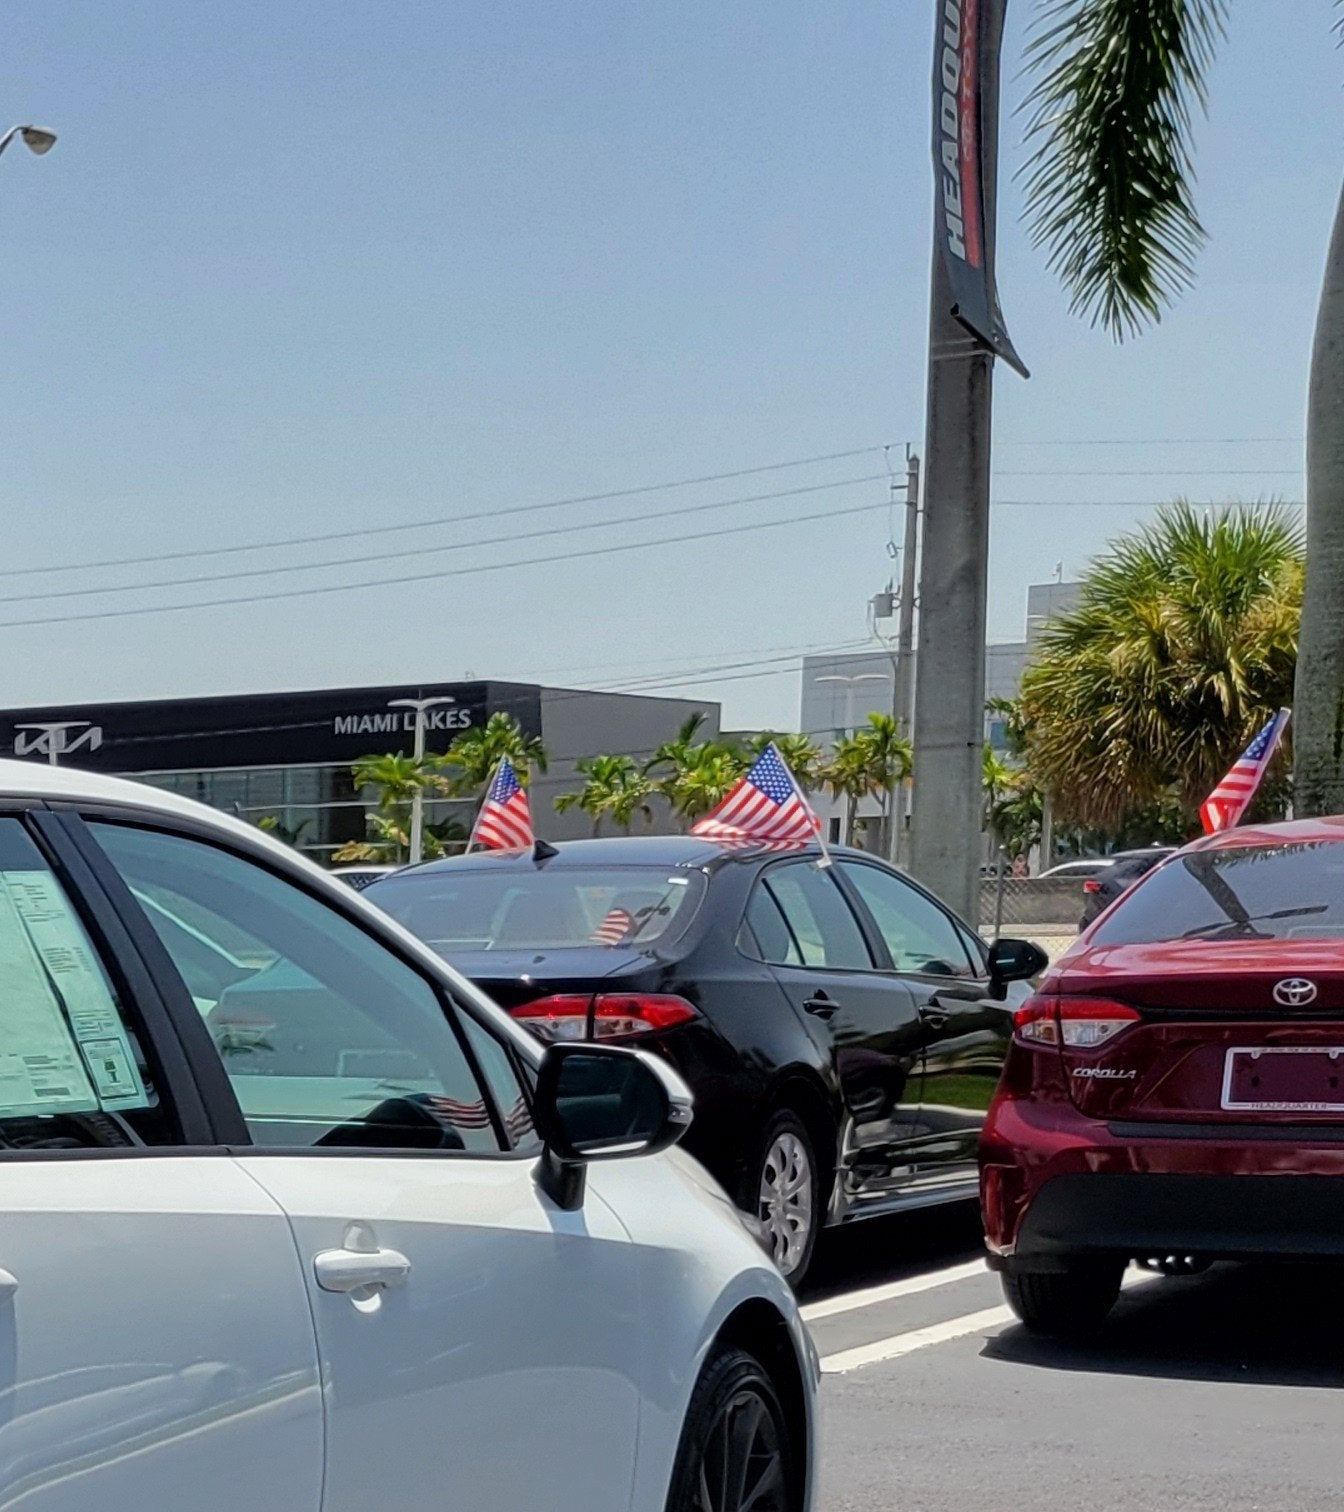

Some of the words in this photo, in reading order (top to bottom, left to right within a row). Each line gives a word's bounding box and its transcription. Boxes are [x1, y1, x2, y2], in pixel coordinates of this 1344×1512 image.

[941, 0, 966, 261] HEADQU
[334, 713, 398, 735] MIAMI
[1072, 1067, 1137, 1080] COROLLA
